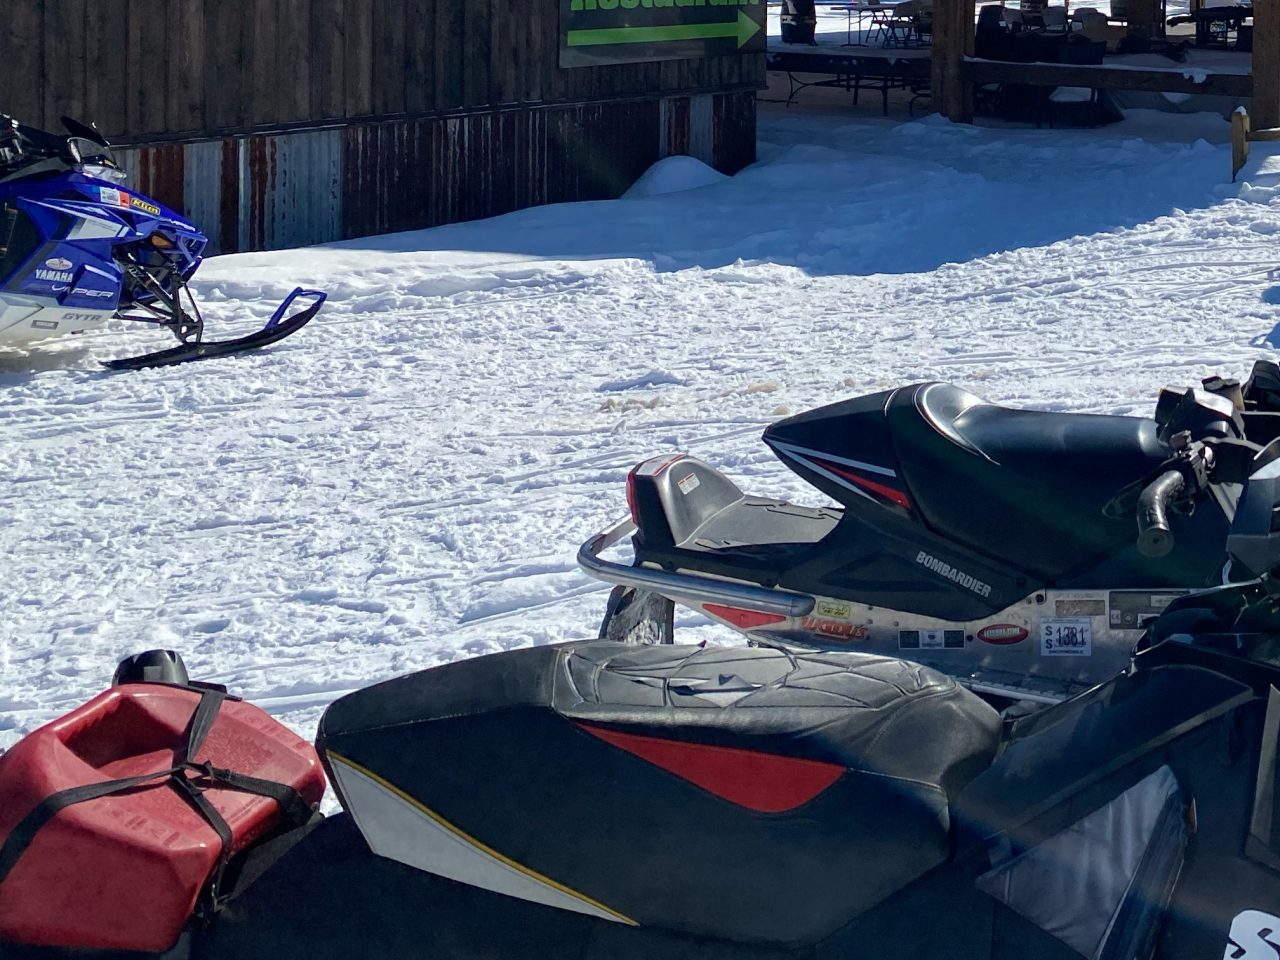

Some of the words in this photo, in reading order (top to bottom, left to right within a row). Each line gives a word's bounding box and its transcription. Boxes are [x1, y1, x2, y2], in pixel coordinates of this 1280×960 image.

[35, 269, 74, 283] YAMAHA
[51, 284, 114, 298] VIPER
[62, 313, 102, 321] GYTR
[916, 550, 992, 598] BOMBARDIER
[1045, 625, 1053, 636] S
[1056, 625, 1085, 646] 1381
[1045, 638, 1053, 649] S
